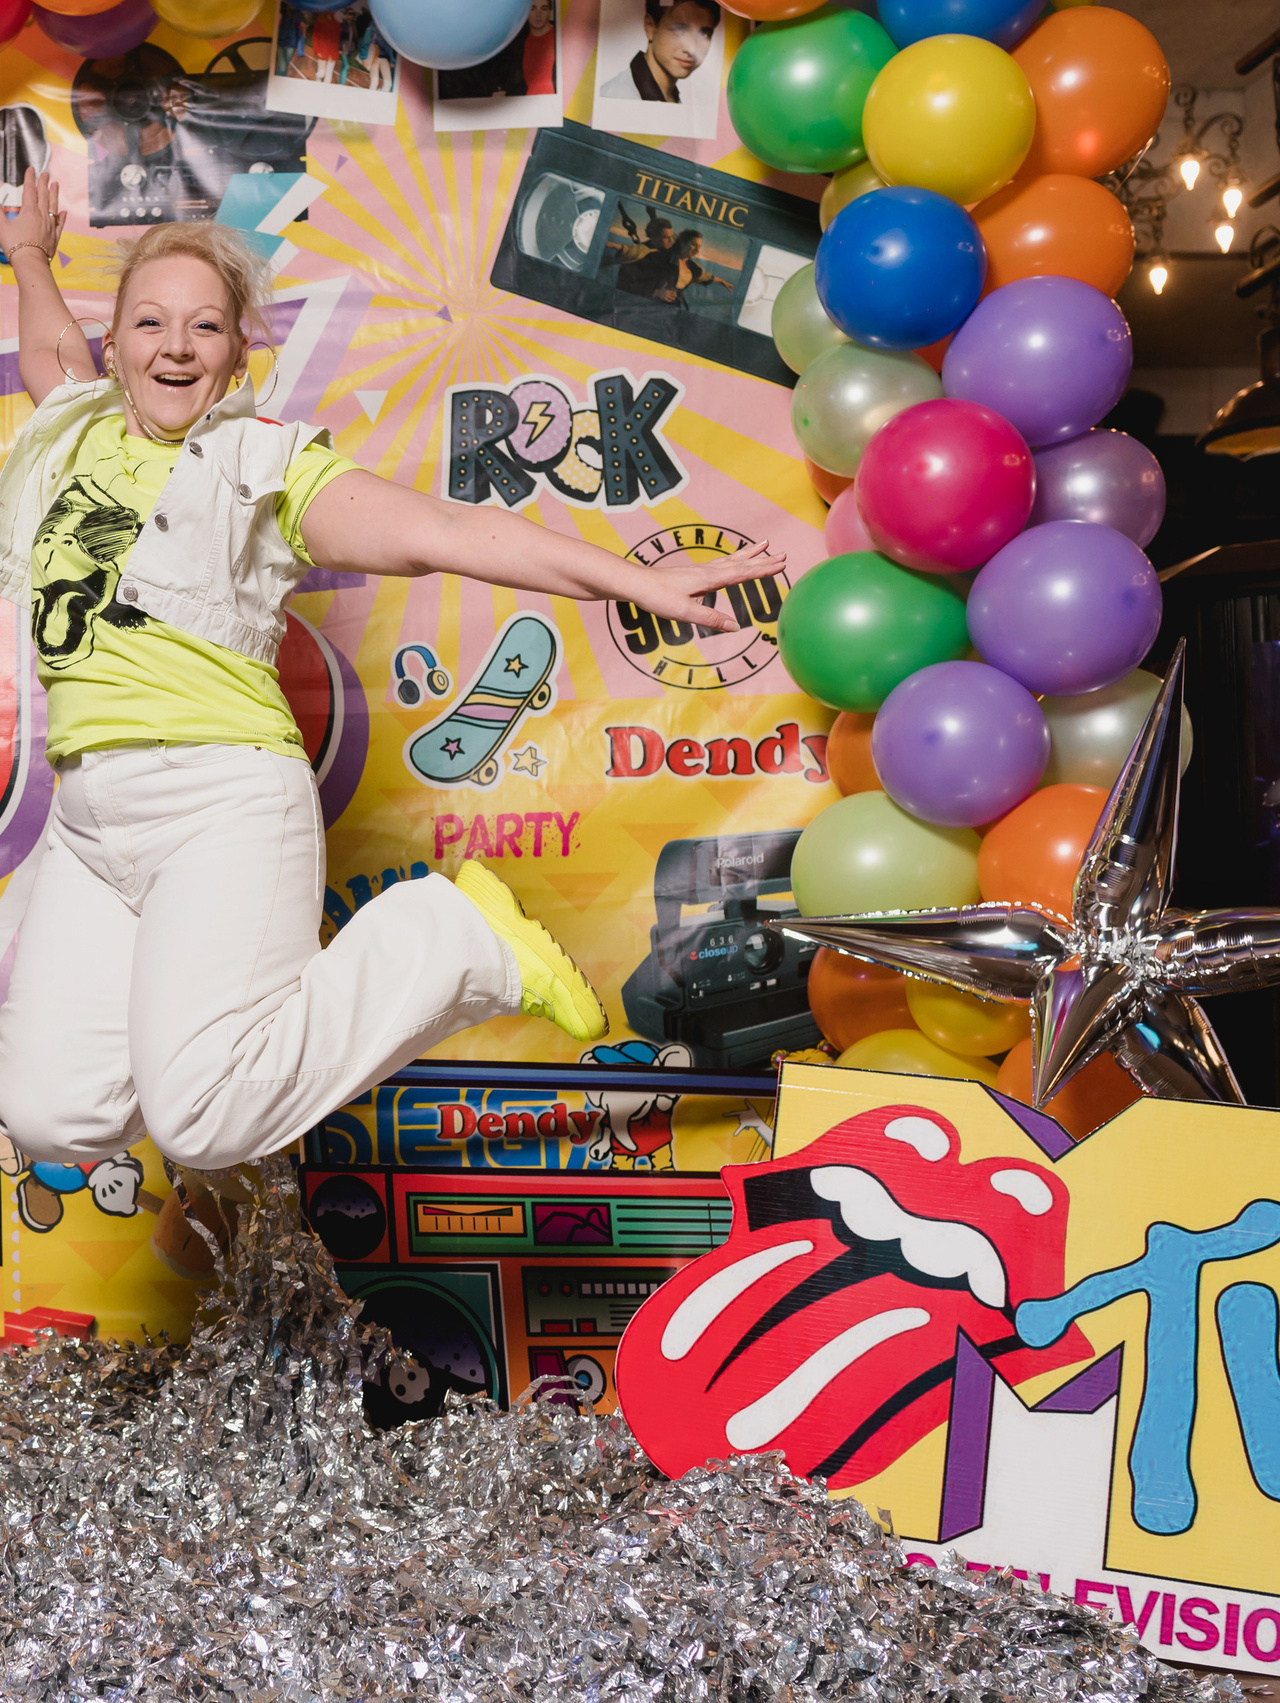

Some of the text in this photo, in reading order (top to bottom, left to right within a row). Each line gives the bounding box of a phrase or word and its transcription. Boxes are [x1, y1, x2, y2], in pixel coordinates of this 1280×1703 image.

[635, 172, 750, 229] TITANIC
[448, 374, 684, 507] ROCK
[633, 528, 748, 566] EVERLY
[605, 723, 830, 784] Dendy
[433, 811, 581, 860] PARTY
[716, 852, 765, 869] Polaroid
[437, 1102, 602, 1145] Dendy
[967, 1560, 1280, 1664] EVISIO
